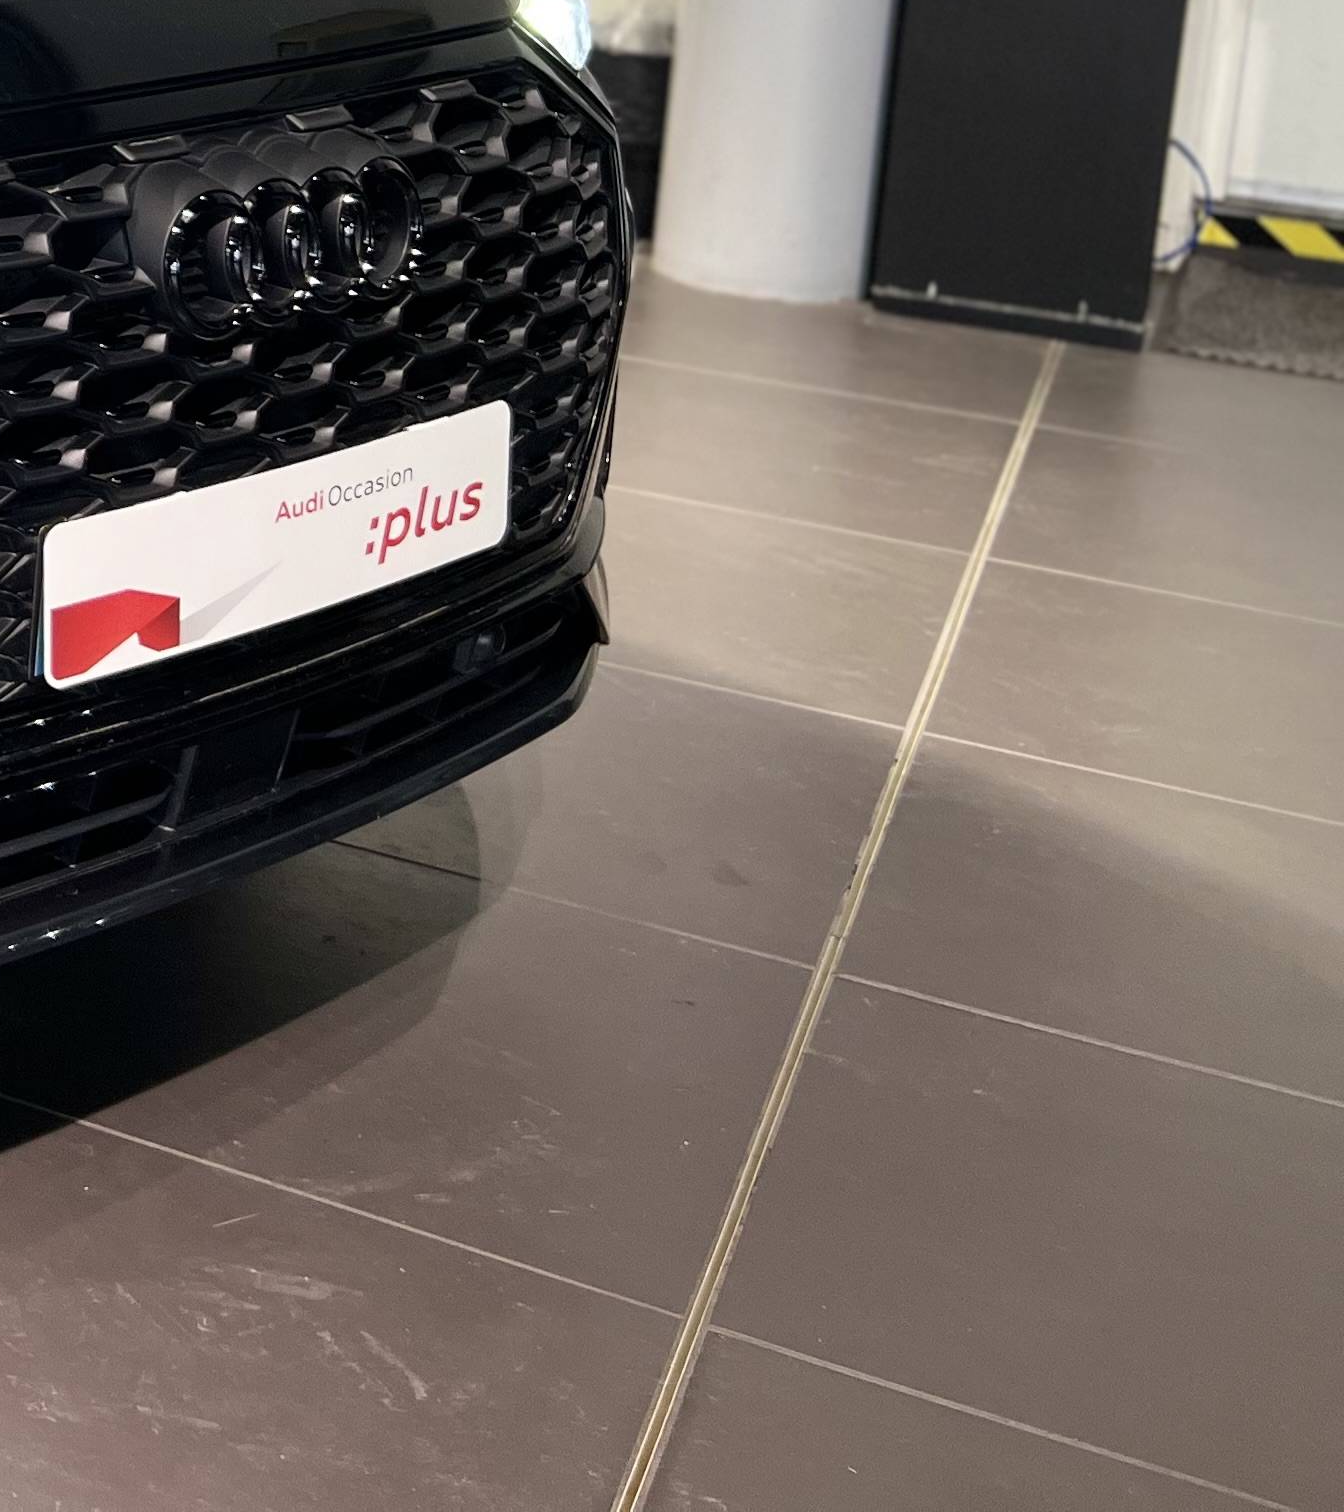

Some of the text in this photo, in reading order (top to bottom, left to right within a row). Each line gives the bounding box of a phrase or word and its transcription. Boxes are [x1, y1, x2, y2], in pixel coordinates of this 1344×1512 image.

[274, 466, 414, 523] Audi Occasion
[364, 481, 484, 564] :plus
